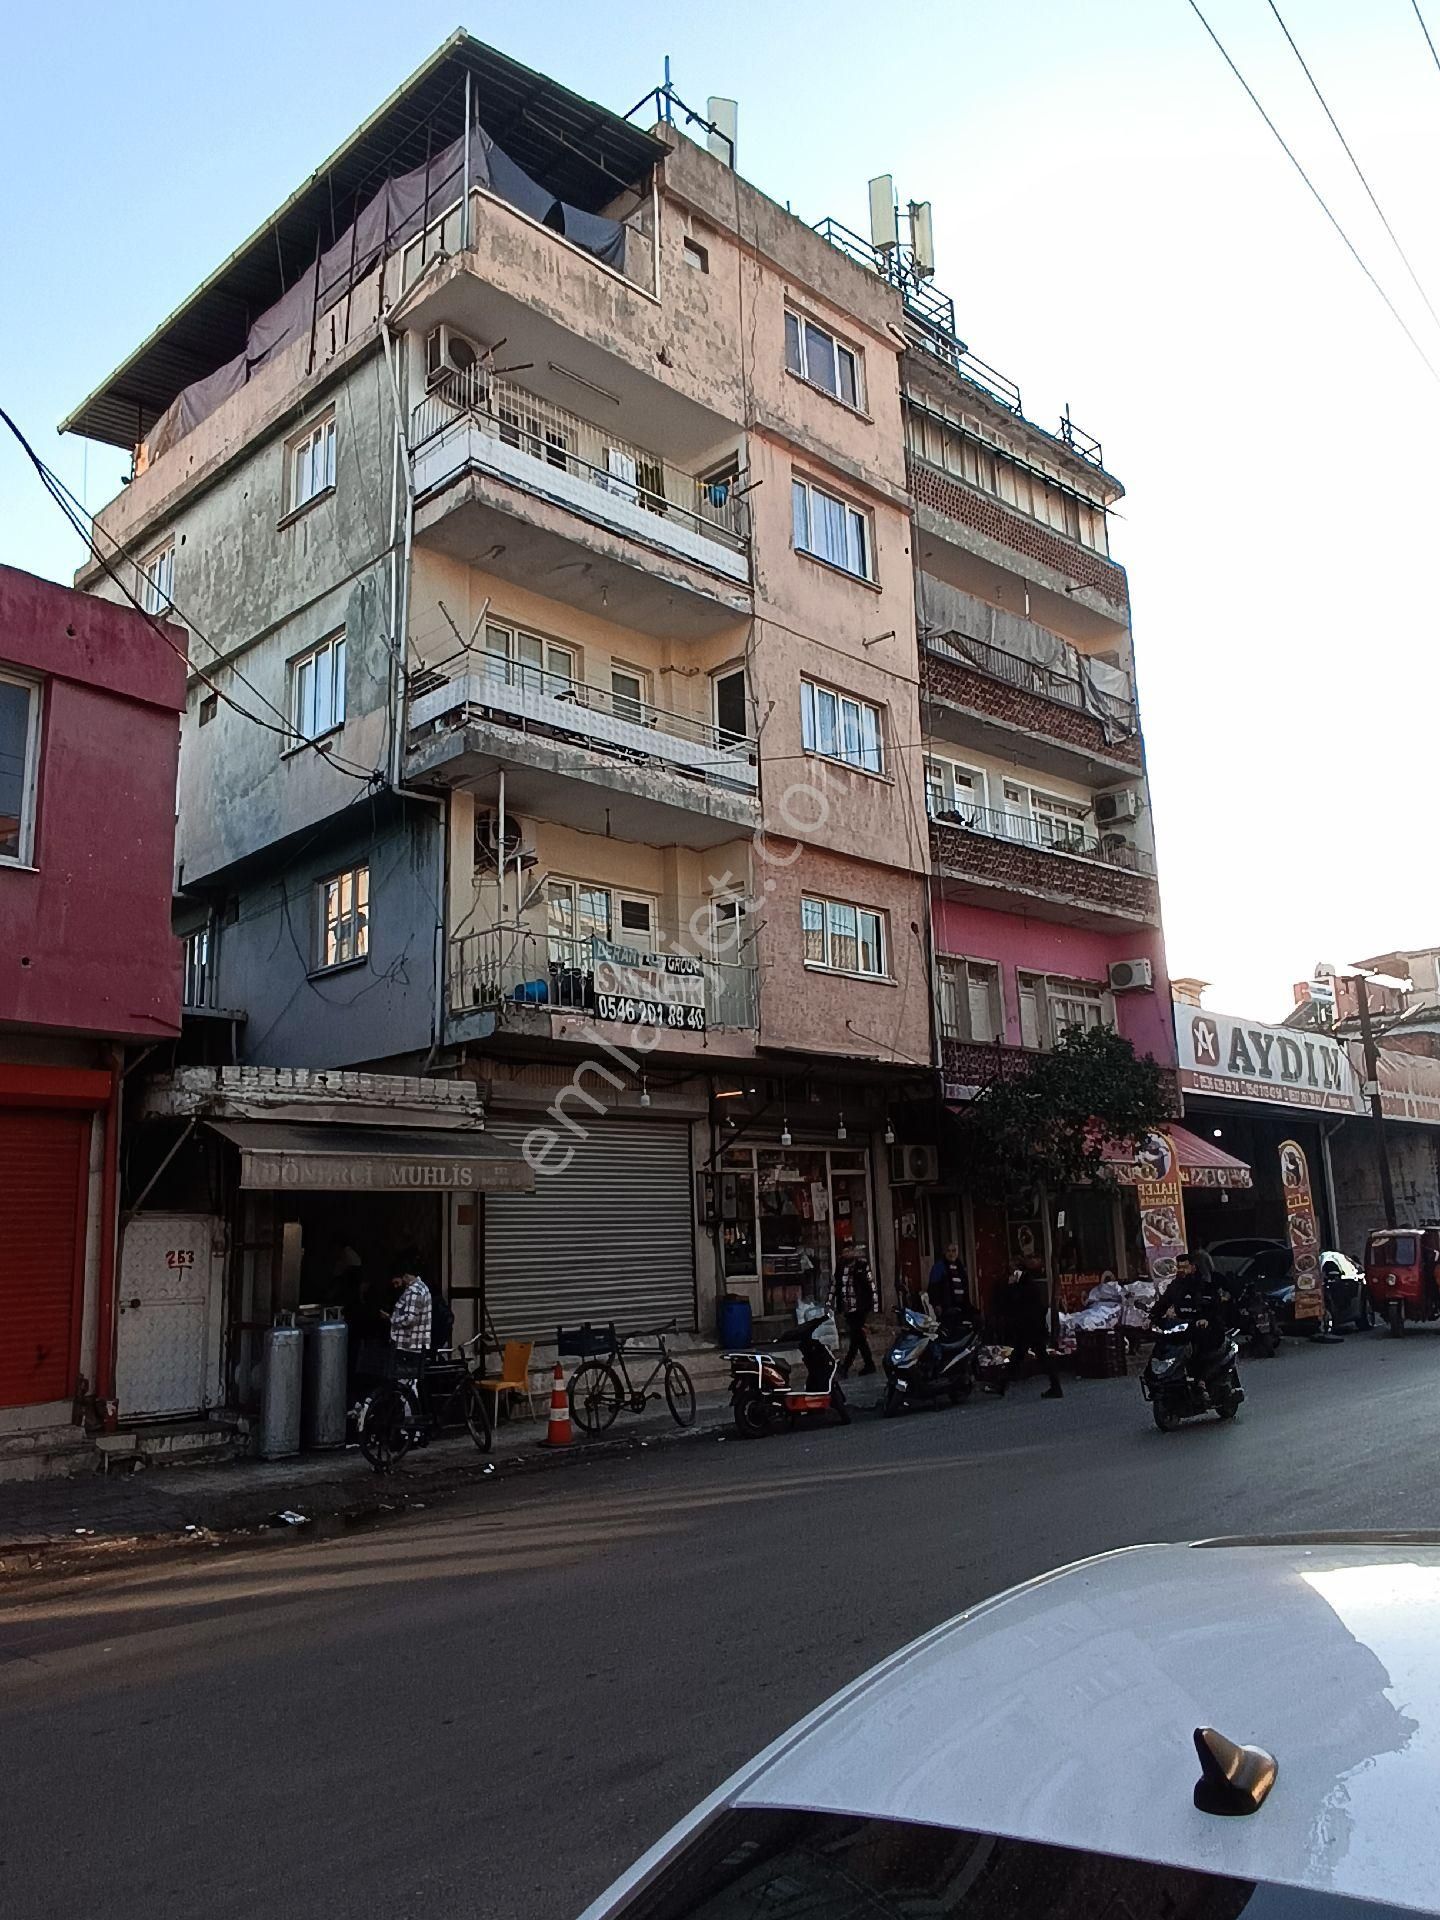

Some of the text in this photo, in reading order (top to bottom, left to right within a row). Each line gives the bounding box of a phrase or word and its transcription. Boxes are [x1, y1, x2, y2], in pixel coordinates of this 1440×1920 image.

[667, 957, 700, 973] GROUP
[599, 995, 704, 1030] 0546 201 89 40
[1228, 1027, 1342, 1091] AYDIN
[388, 1163, 473, 1187] MUHLİS
